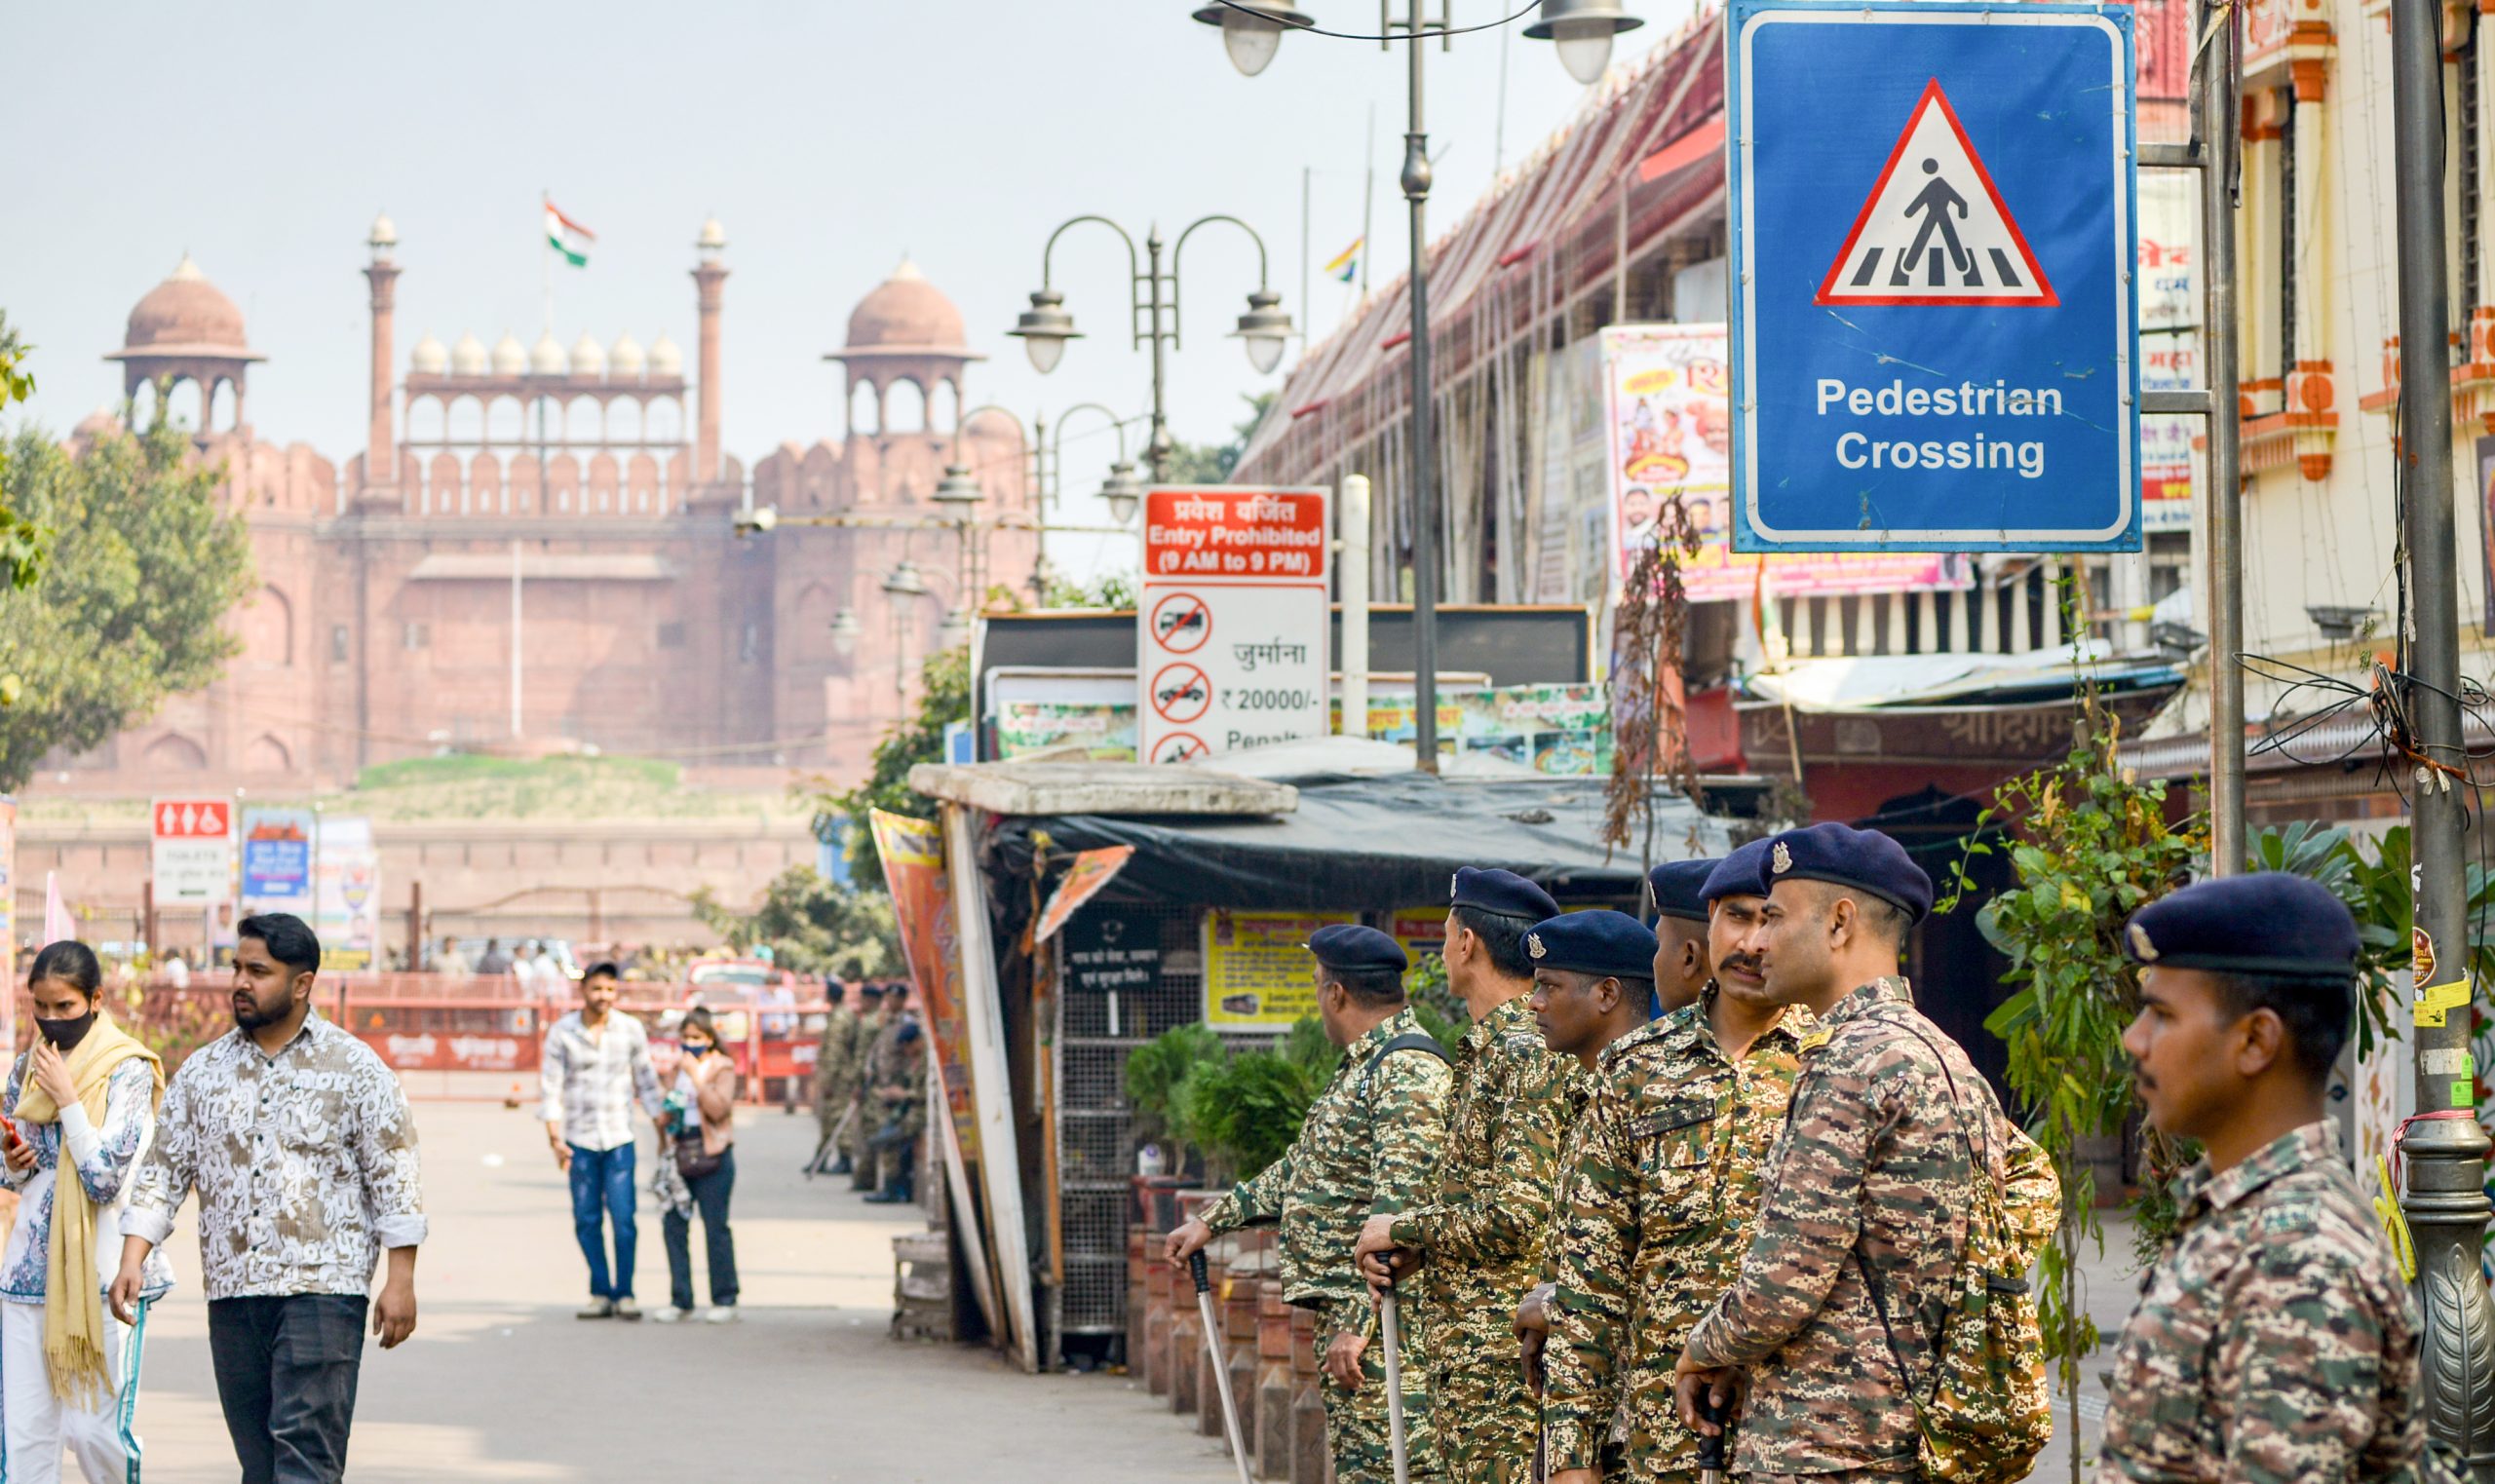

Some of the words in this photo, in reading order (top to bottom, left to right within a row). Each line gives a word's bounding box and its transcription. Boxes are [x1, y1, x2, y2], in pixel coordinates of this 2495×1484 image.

[1817, 378, 2062, 416] Pedestrian
[1836, 432, 2045, 478] Crossing
[1173, 494, 1225, 522] प्रवेश
[1236, 494, 1297, 522] वर्जित
[1149, 525, 1207, 549] Entry
[1210, 525, 1321, 547] Prohibited
[1159, 551, 1180, 574] (9
[1183, 551, 1219, 570] AM
[1223, 552, 1247, 571] to
[1250, 552, 1264, 571] 9
[1269, 552, 1311, 575] PM)
[1233, 635, 1307, 671] जुर्माना
